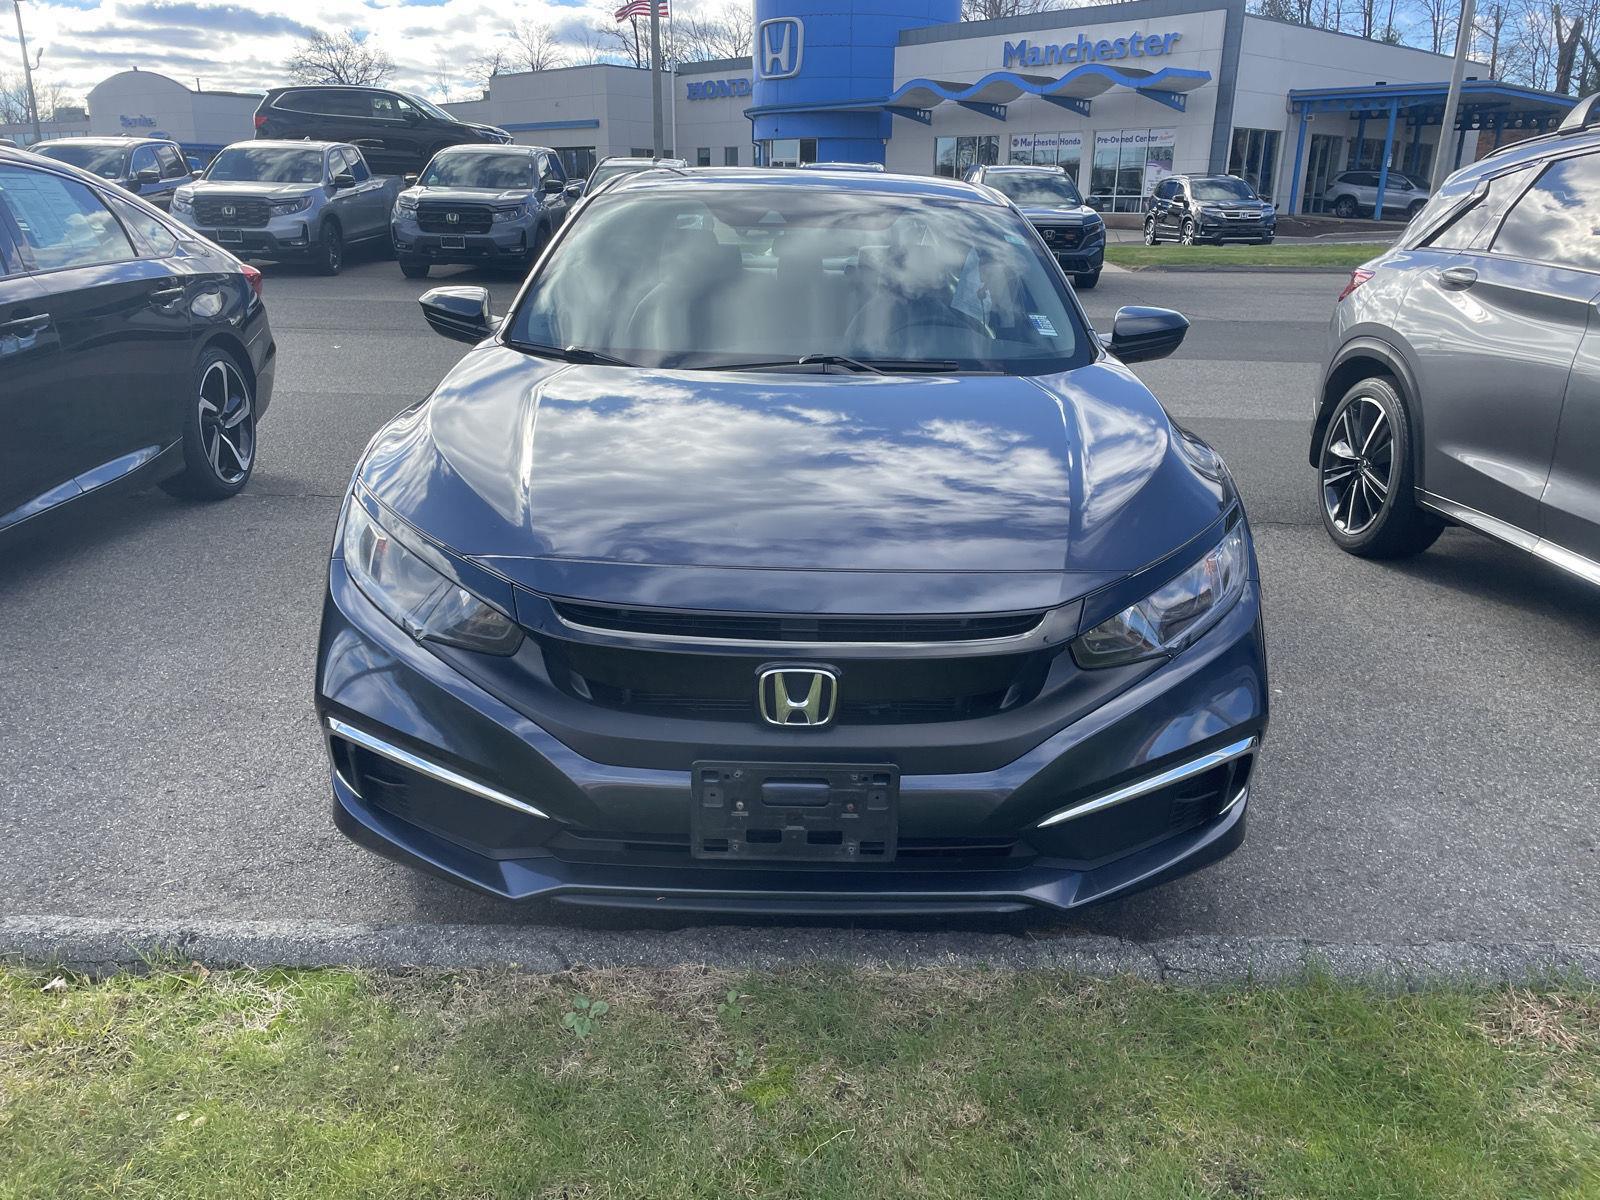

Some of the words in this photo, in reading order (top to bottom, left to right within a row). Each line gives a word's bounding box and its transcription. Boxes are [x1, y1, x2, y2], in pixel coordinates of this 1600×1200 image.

[1003, 31, 1182, 68] Manchester
[687, 78, 752, 100] HOND
[1060, 137, 1081, 146] Honda
[1135, 134, 1159, 143] Center
